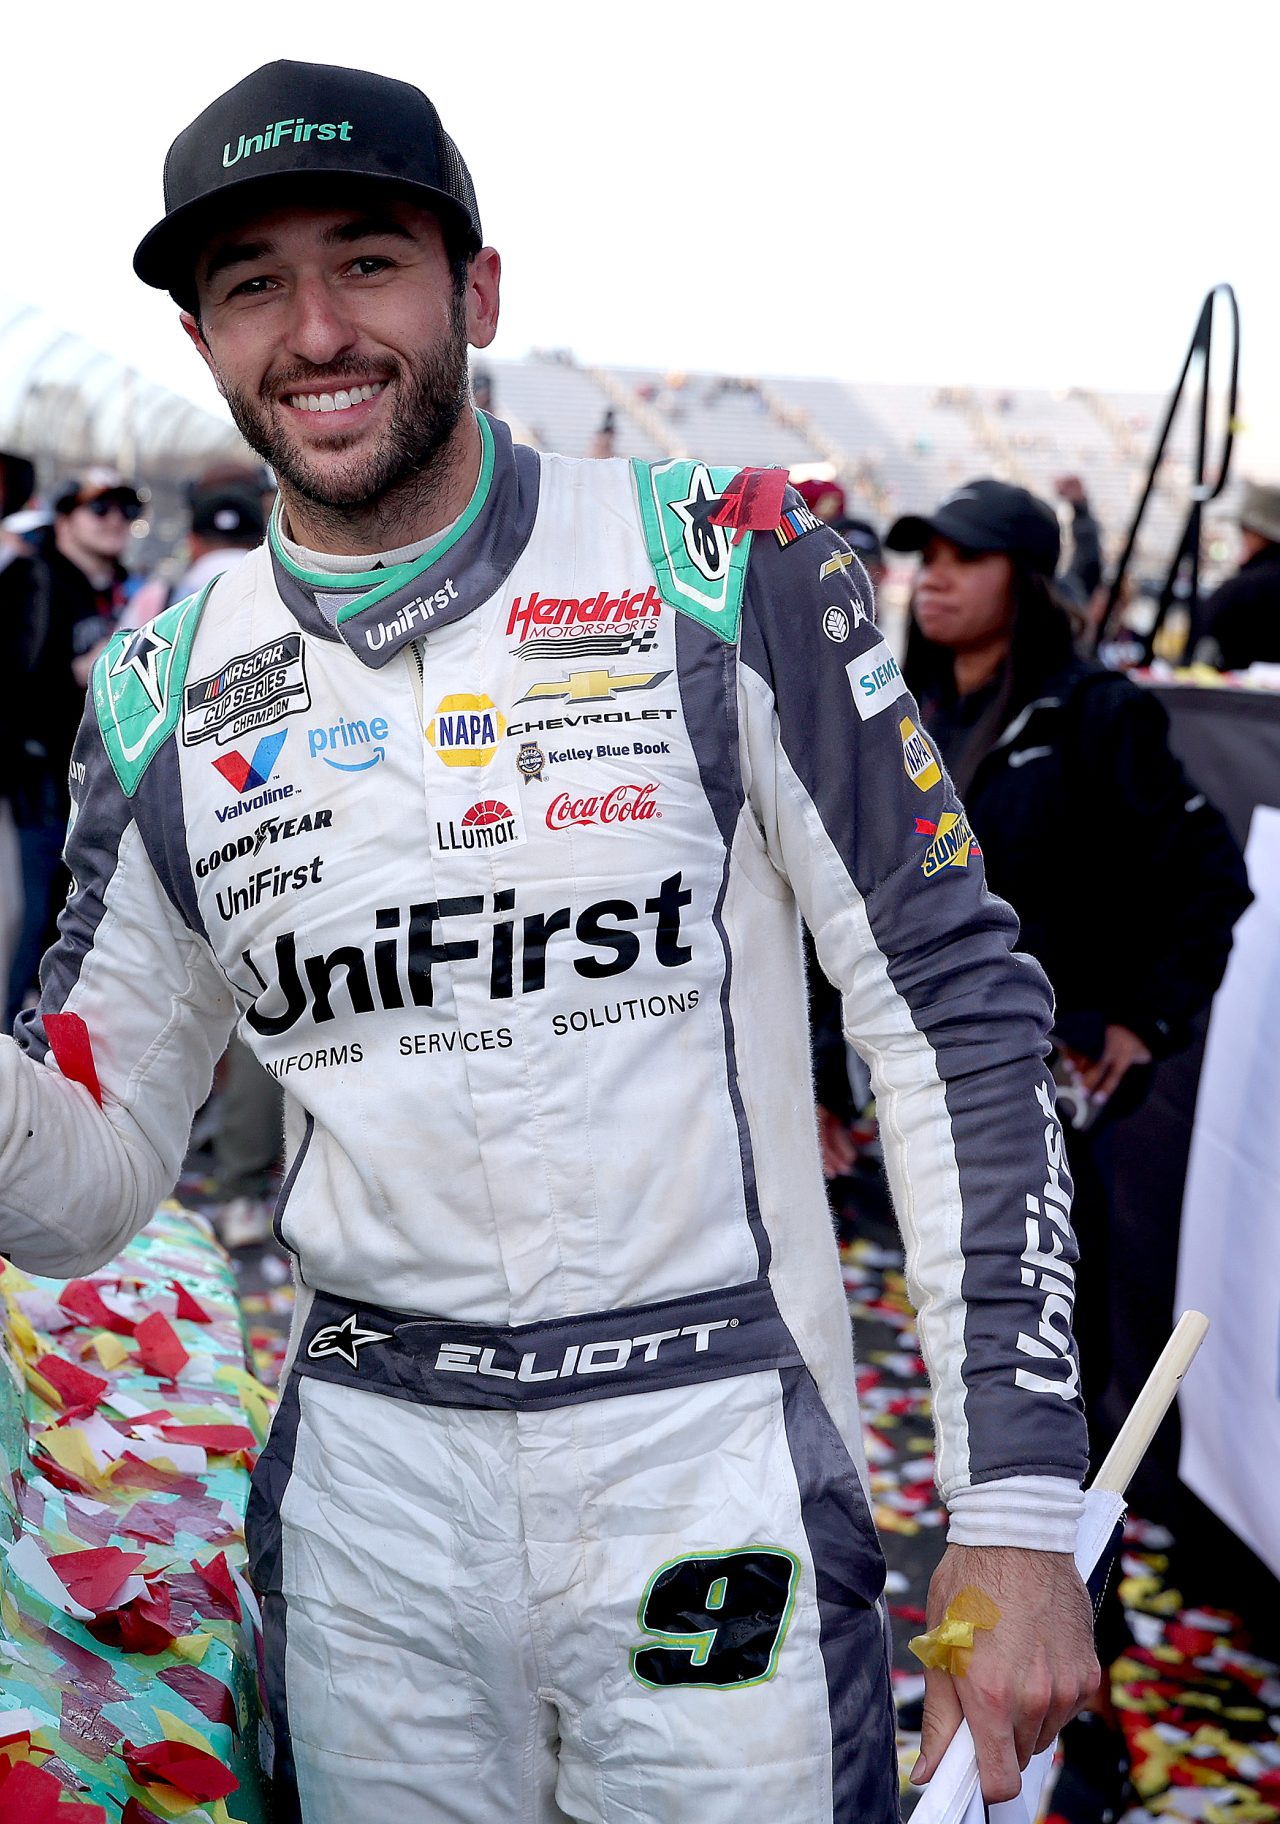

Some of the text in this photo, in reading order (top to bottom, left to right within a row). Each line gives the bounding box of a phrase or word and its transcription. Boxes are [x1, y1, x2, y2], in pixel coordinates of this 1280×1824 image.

[222, 118, 353, 168] UniFirst
[365, 578, 459, 651] UniFirst
[506, 585, 663, 643] Hendrick
[529, 618, 659, 640] MOTORSPORTS
[223, 644, 284, 689] NASCAR
[204, 669, 288, 725] CUP SERIES
[232, 698, 289, 734] CHAMPION
[307, 716, 389, 758] prime
[439, 713, 496, 747] NAPA
[506, 709, 678, 737] CHEVROLET
[548, 741, 671, 764] Kelley Blue Book
[904, 734, 932, 775] NAPA
[215, 783, 295, 823] Valvoline
[545, 783, 661, 831] Coca-Cola
[195, 809, 333, 879] GOODYEAR
[436, 818, 517, 851] LLumar
[216, 856, 324, 922] UniFirst
[242, 870, 693, 1037] UniFirst
[399, 1028, 513, 1056] SERVICES
[551, 989, 700, 1037] SOLUTIONS
[1015, 1080, 1079, 1401] UniFirst
[434, 1319, 730, 1383] ELLIOTT
[630, 1546, 800, 1690] 9
